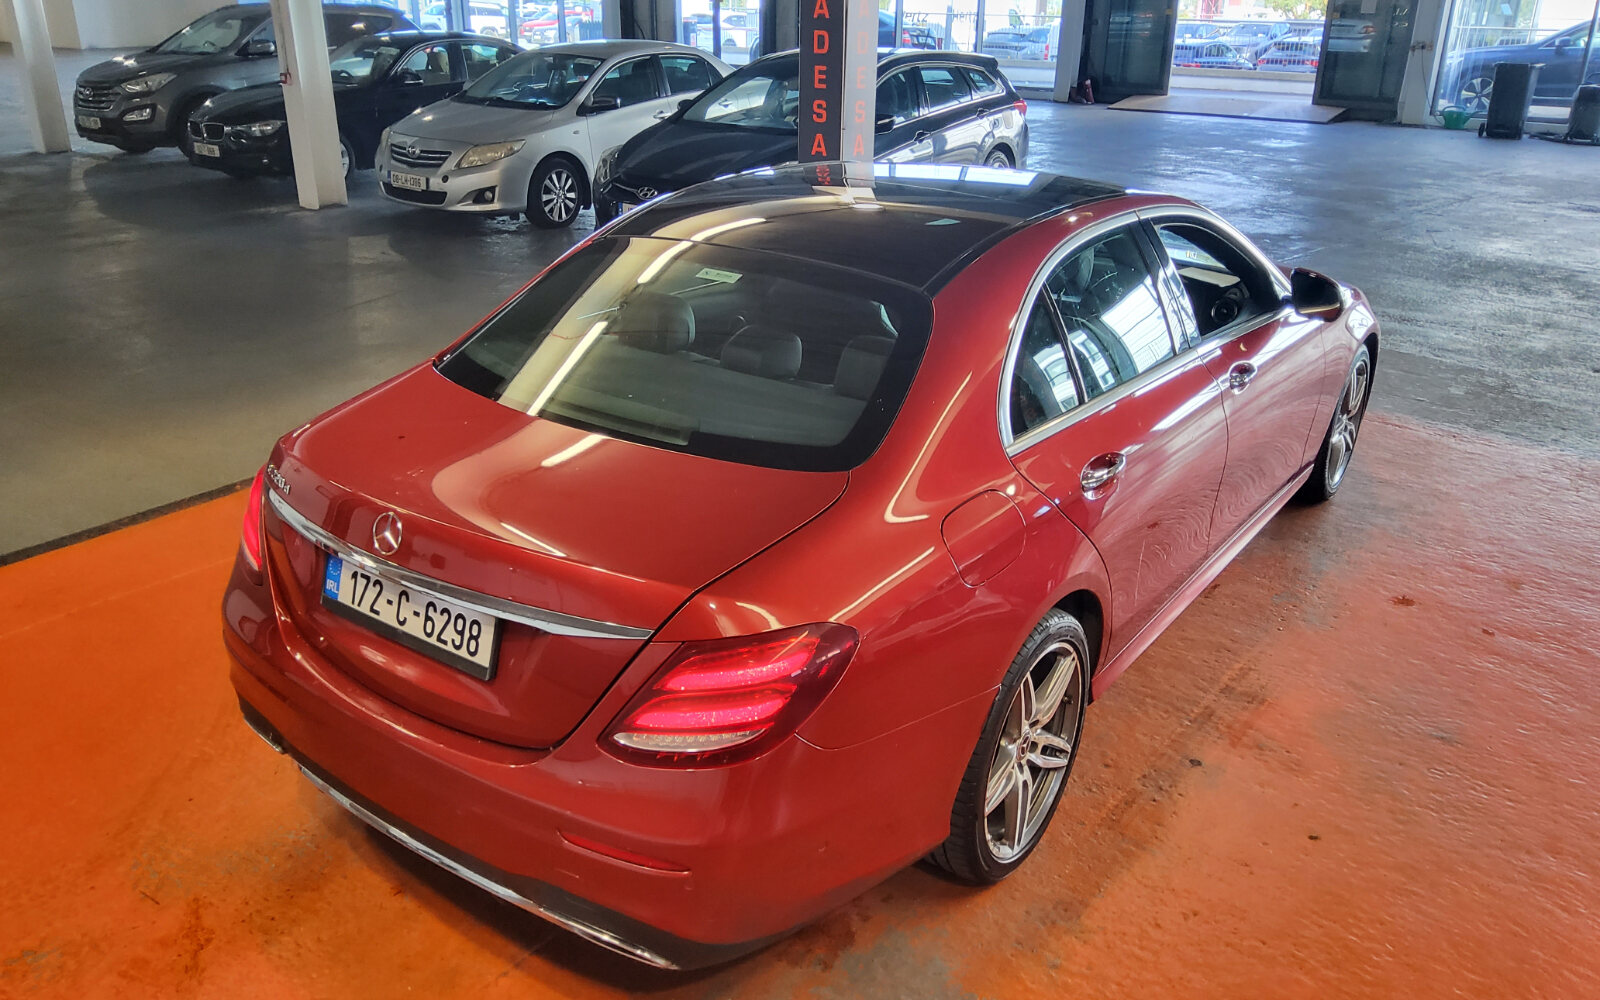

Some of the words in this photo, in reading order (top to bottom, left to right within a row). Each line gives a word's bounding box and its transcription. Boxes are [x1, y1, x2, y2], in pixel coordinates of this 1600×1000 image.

[811, 0, 830, 157] ADESA
[853, 0, 871, 157] ADESA
[326, 578, 340, 595] IRL
[351, 570, 483, 658] 172-C-6298
